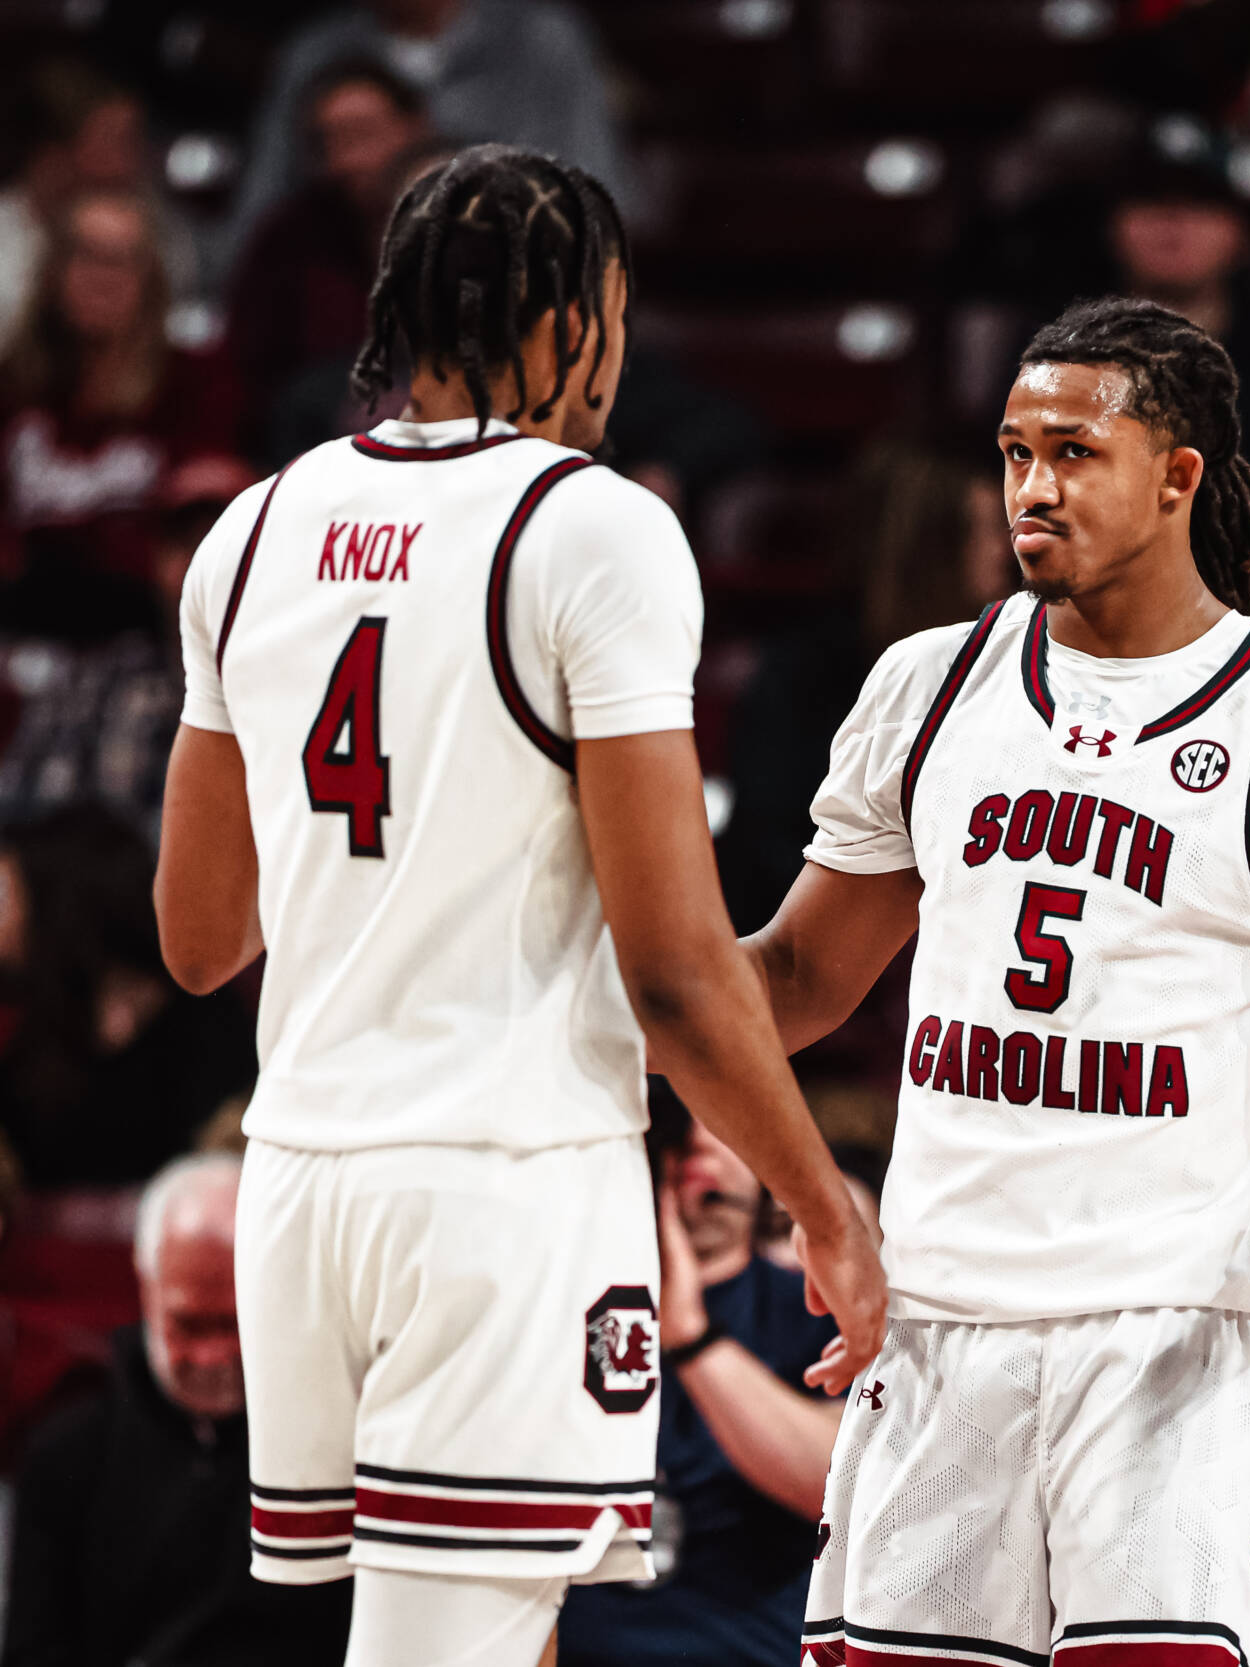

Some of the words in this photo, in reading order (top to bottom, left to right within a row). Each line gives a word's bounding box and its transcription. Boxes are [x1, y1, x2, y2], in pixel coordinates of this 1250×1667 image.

[317, 521, 423, 581] KNOX
[302, 614, 392, 860] 4
[1175, 743, 1226, 788] SEC
[963, 789, 1174, 907] SOUTH
[1004, 881, 1087, 1014] 5
[909, 1014, 1189, 1117] CAROLINA
